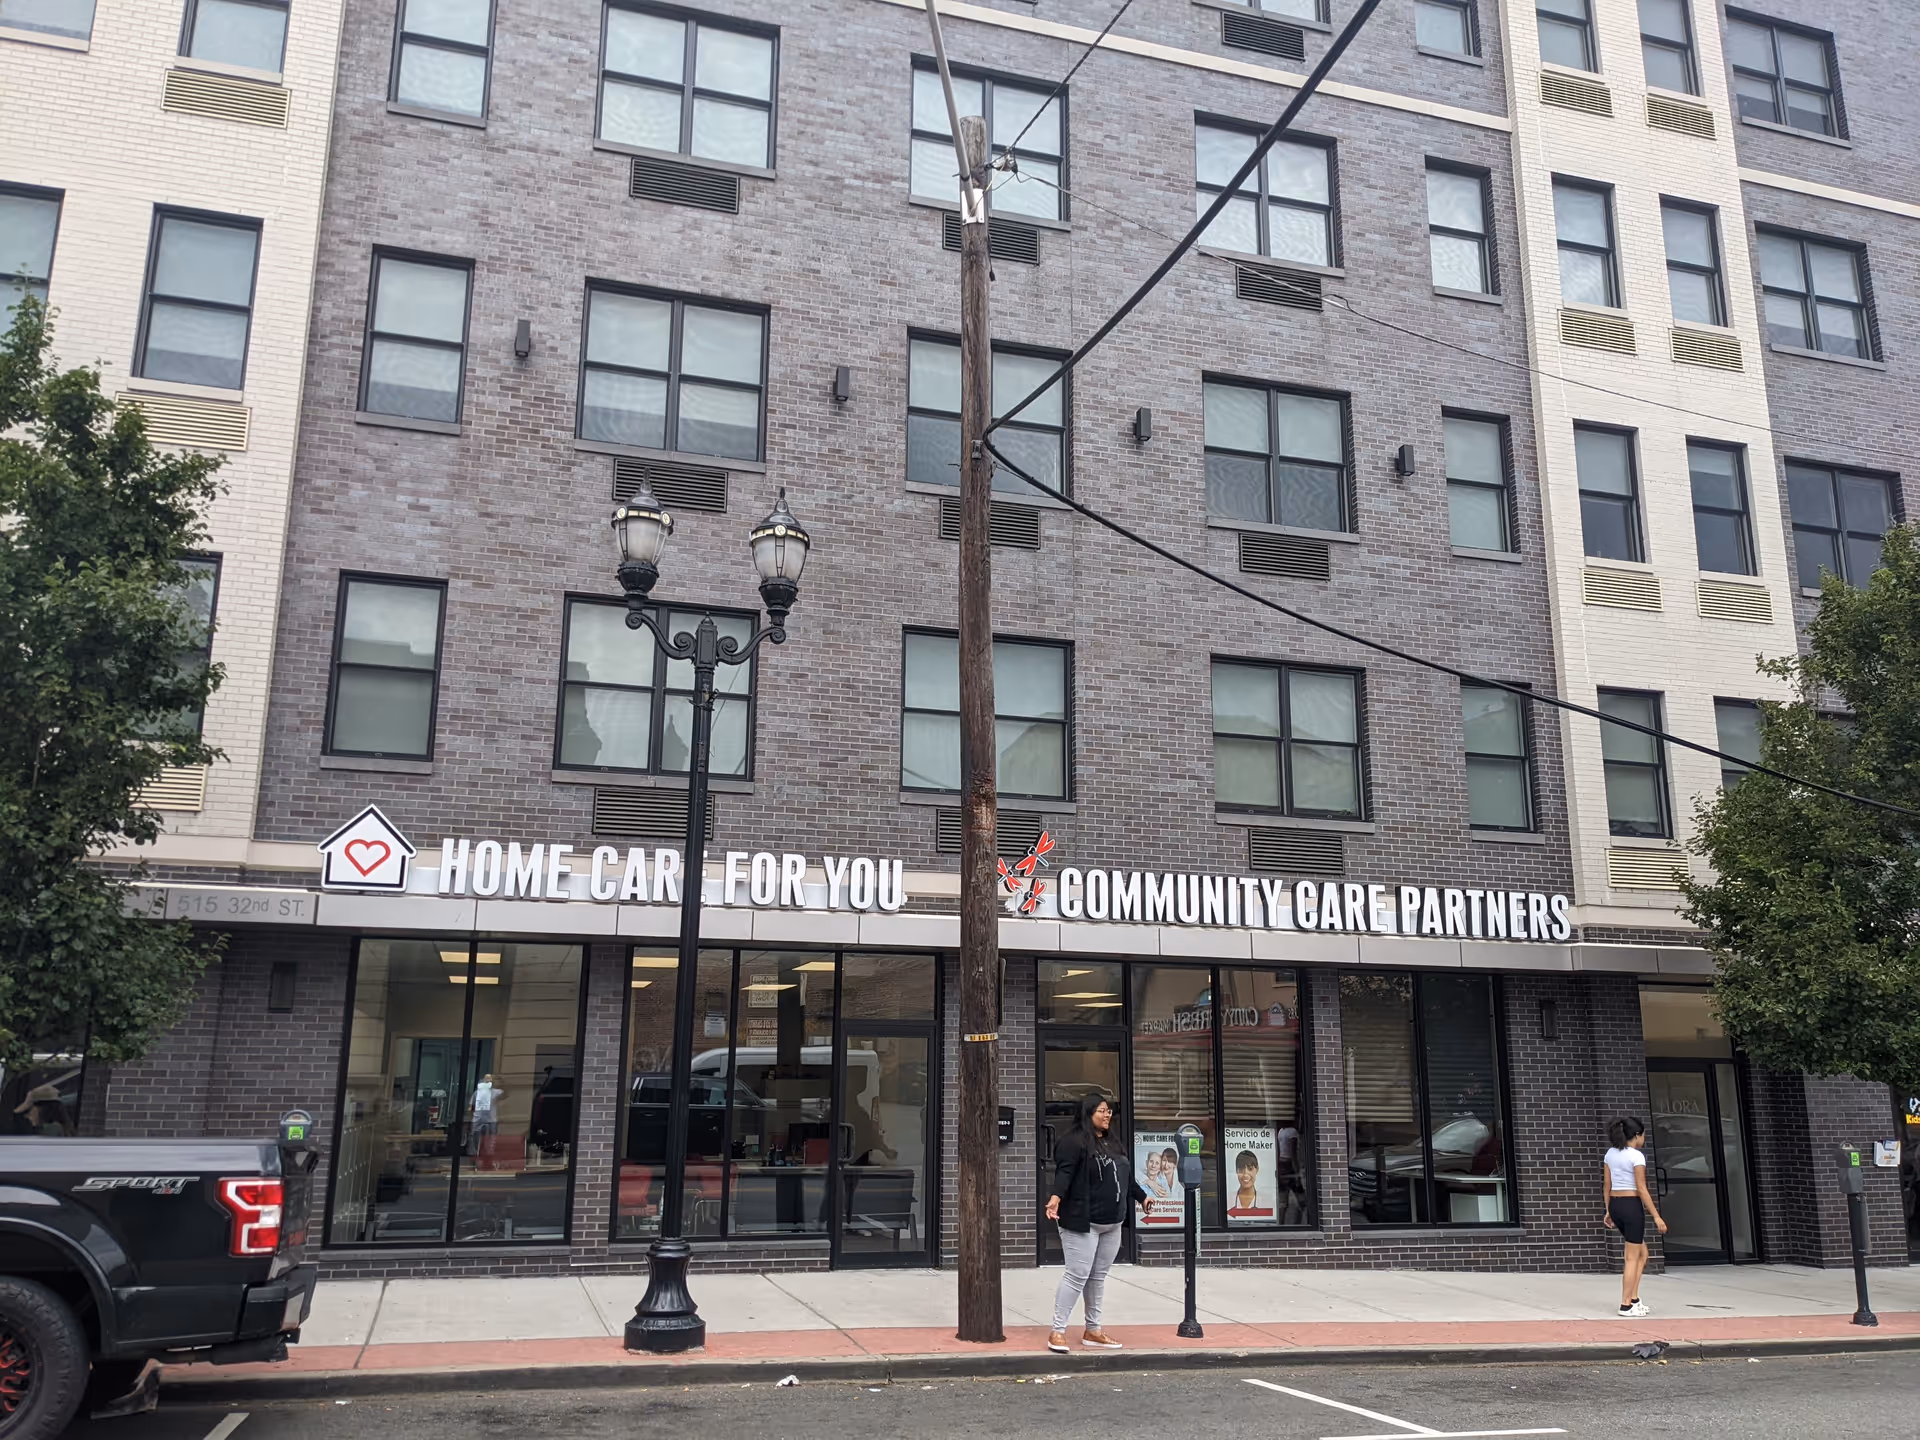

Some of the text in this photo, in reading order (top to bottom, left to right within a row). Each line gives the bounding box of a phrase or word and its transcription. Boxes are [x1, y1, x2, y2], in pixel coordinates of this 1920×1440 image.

[438, 838, 904, 912] HOME CAR FOR YOU
[177, 895, 305, 917] 515 32nd ST.
[1057, 867, 1571, 941] COMMUNITY CARE PARTNERS
[1225, 1129, 1271, 1138] Servicio de
[1248, 1140, 1274, 1149] Maker
[71, 1176, 200, 1191] SPORT
